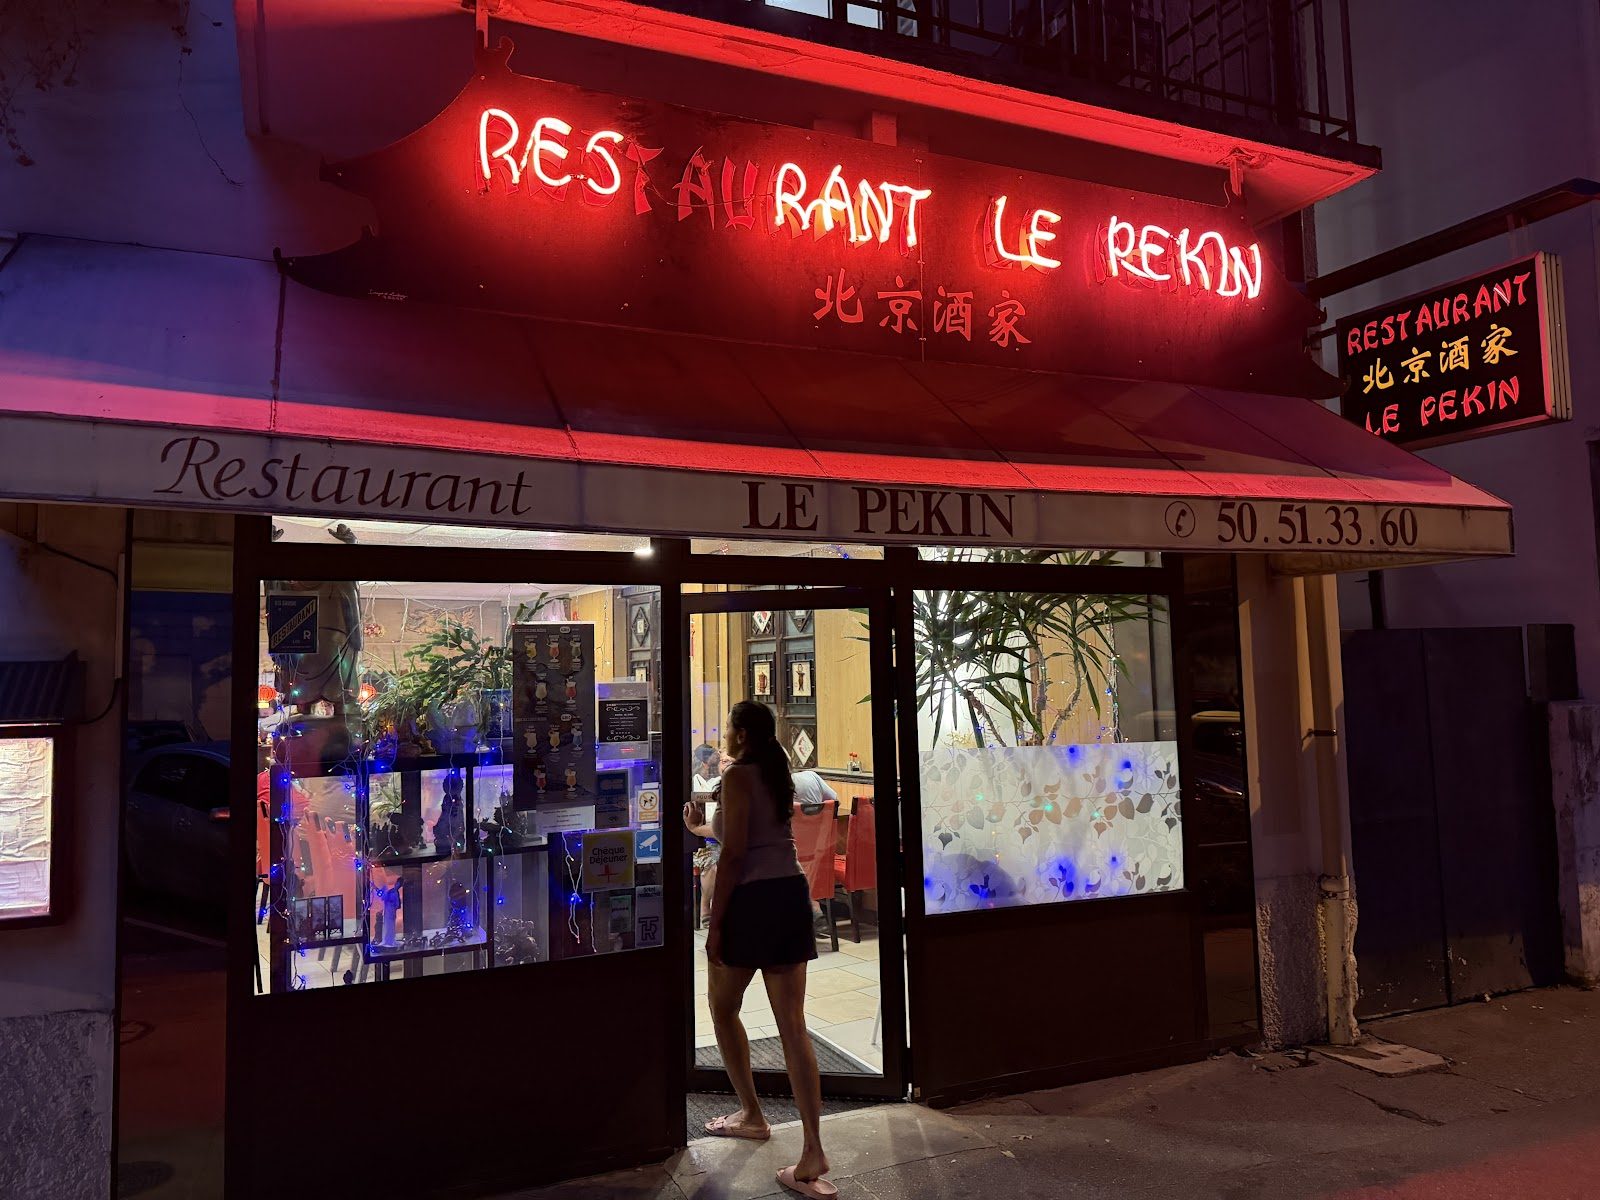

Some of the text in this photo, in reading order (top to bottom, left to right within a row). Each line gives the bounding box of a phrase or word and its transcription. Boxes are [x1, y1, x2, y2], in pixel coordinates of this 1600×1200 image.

[474, 108, 1263, 300] RESTAURANT LE PEKIN
[813, 268, 1031, 348] 北京酒家
[1347, 272, 1531, 356] RESTAURANT
[1362, 323, 1518, 394] 北京酒家
[1420, 376, 1520, 426] PEKIN
[153, 435, 533, 516] Restaurant
[742, 480, 819, 531] LE
[852, 486, 1016, 538] PEKIN
[273, 602, 314, 645] RESTAURANT
[303, 629, 312, 640] R
